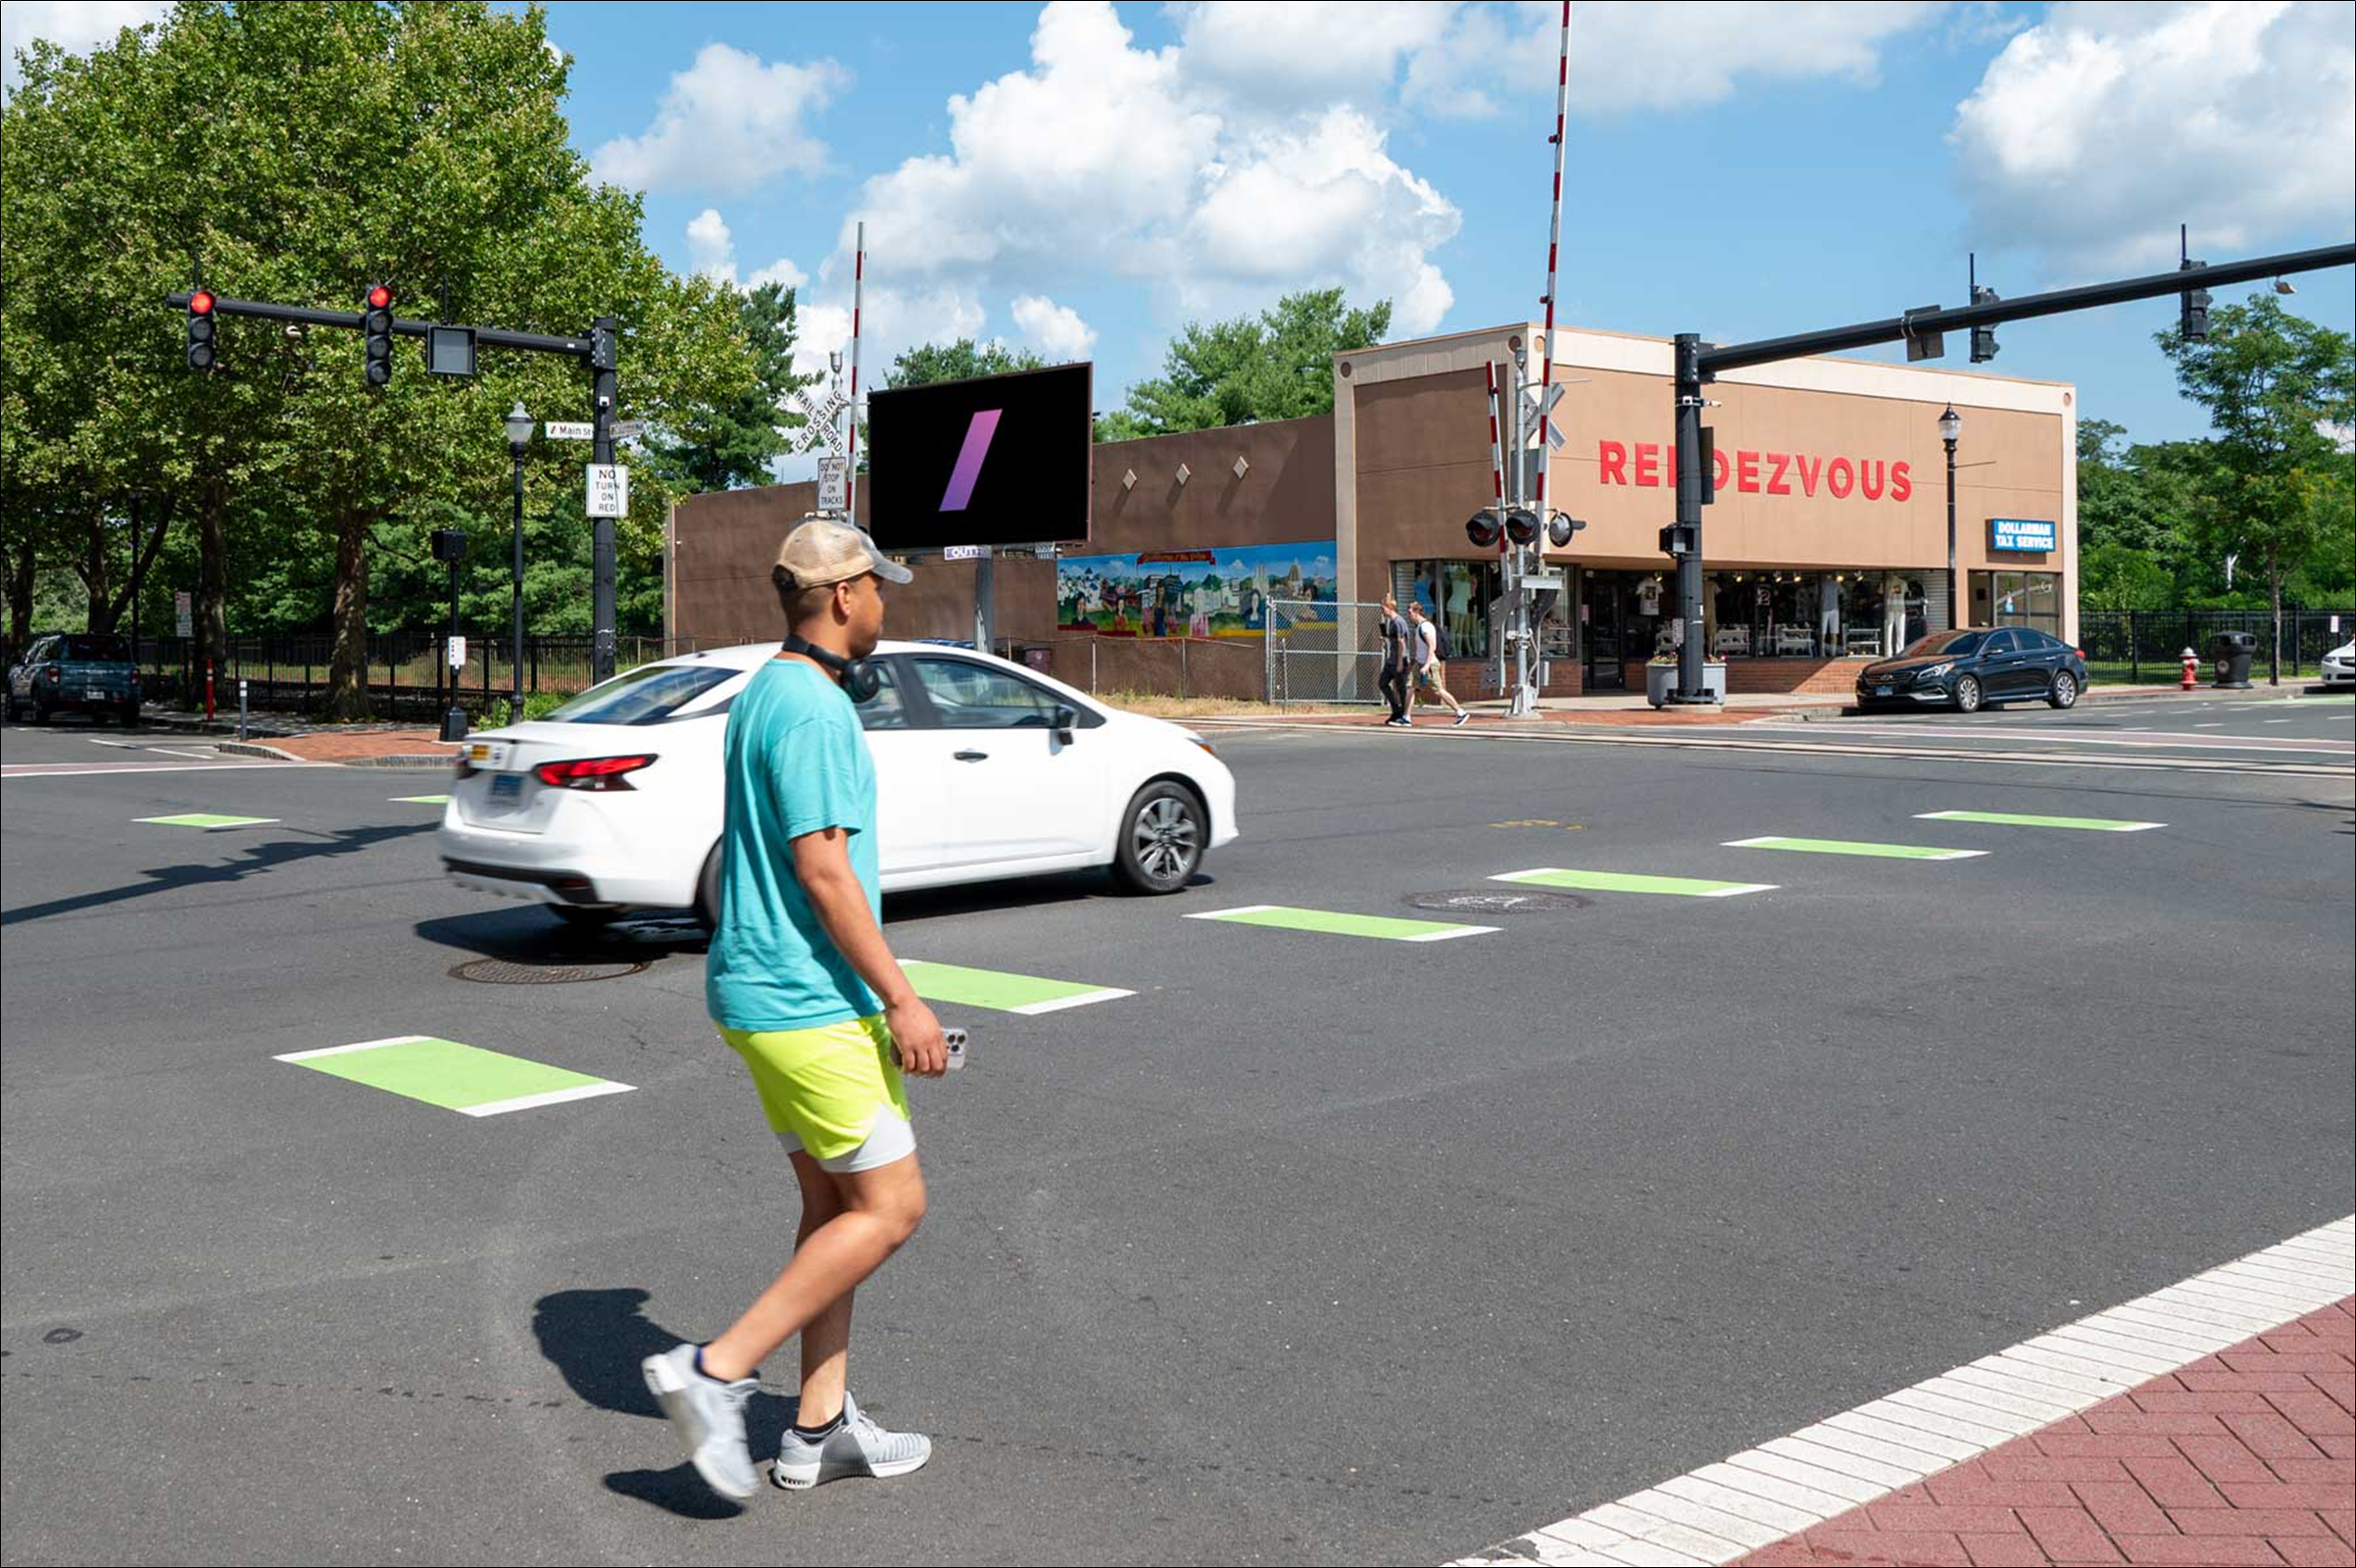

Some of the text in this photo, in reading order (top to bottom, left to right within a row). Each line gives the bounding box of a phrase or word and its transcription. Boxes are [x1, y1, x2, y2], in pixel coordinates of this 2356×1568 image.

[795, 390, 841, 450] CROSSING
[796, 389, 843, 452] RAIL ROAD
[560, 425, 591, 436] Main St
[820, 462, 844, 471] DO NOT
[599, 469, 615, 479] NO
[824, 472, 839, 482] STOP
[595, 481, 620, 490] TURN
[827, 485, 836, 494] ON
[602, 492, 614, 501] ON
[820, 496, 843, 505] TRACKS
[599, 503, 615, 512] RED
[1997, 520, 2051, 535] DOLLARMAN
[1995, 534, 2054, 549] TAX SERVICE
